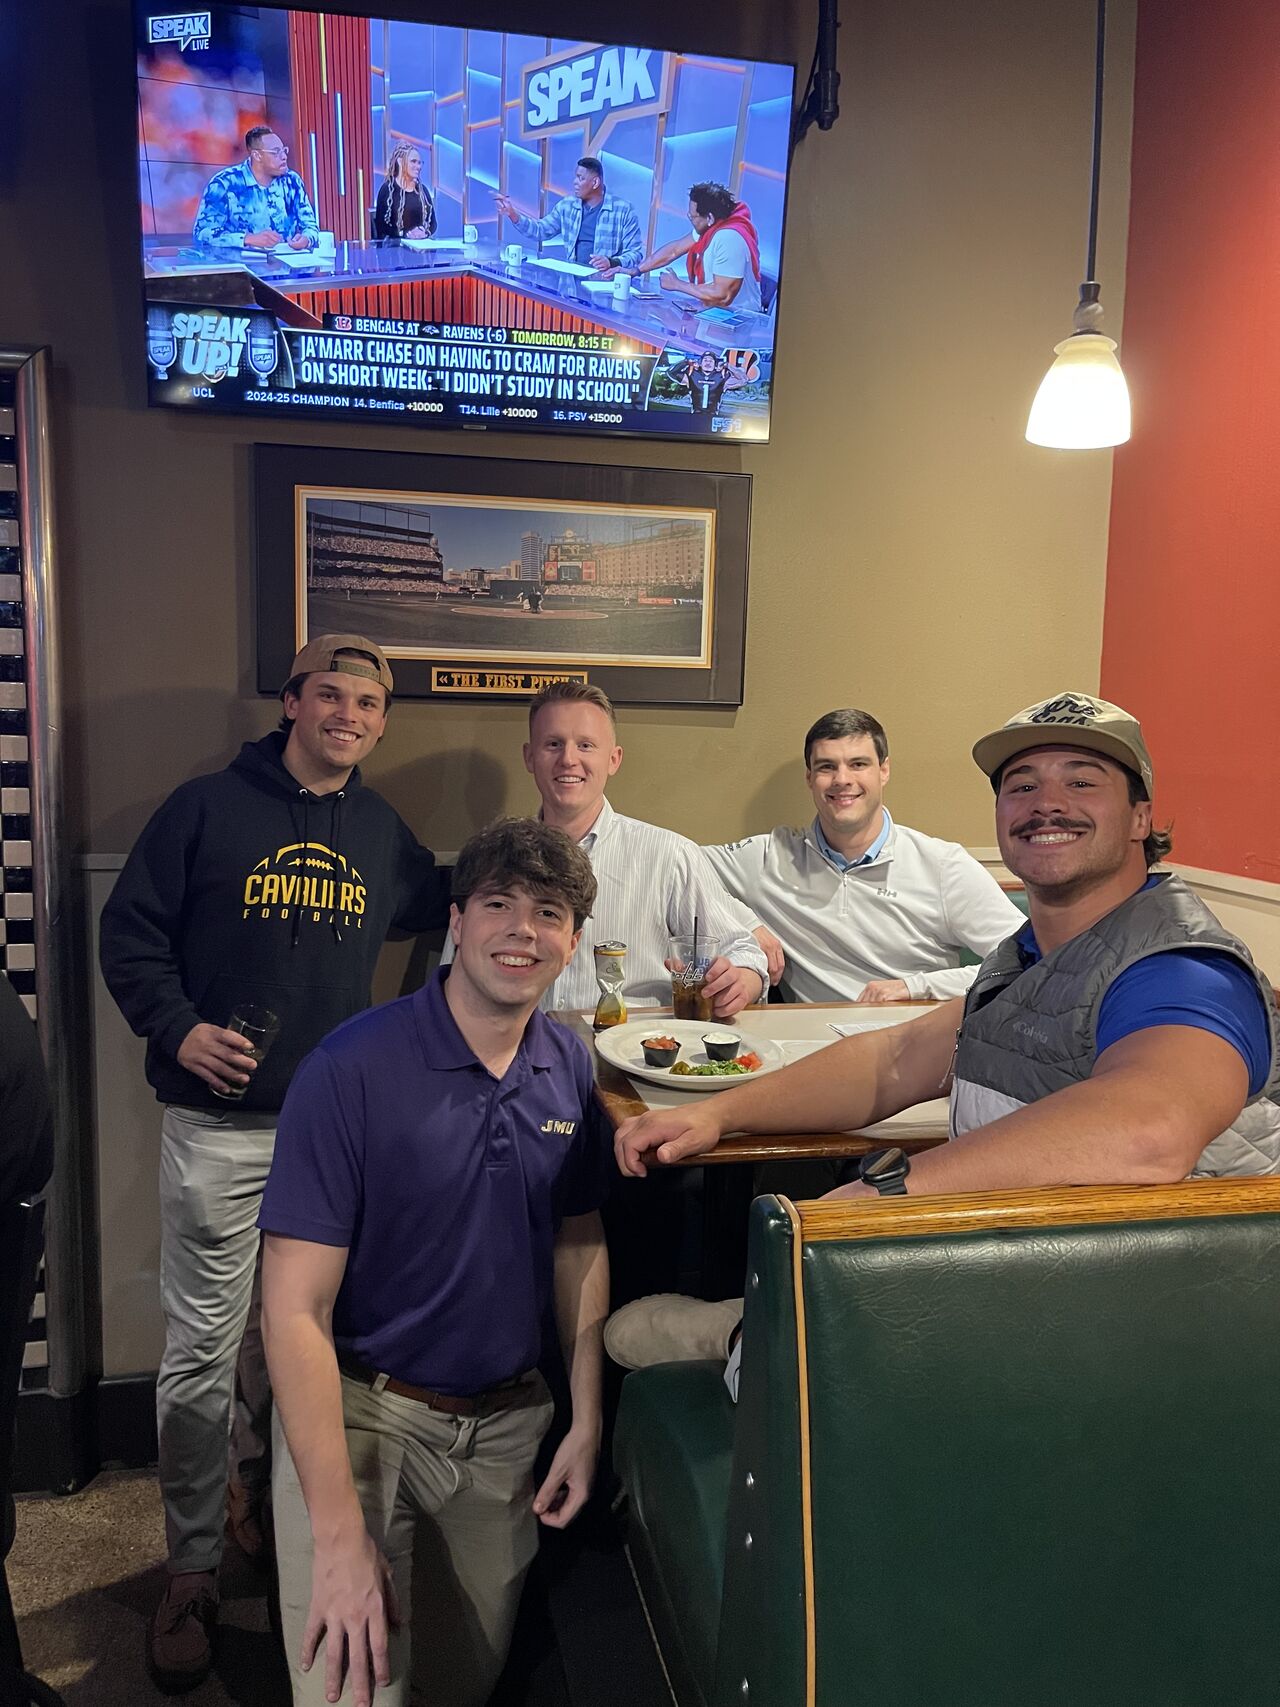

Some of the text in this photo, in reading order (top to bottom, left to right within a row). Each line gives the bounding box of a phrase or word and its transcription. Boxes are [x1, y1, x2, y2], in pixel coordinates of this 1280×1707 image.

[152, 16, 208, 39] SPEAK
[192, 38, 210, 51] LIVE
[528, 47, 655, 127] SPEAK
[172, 313, 250, 343] SPEAK
[356, 318, 614, 350] BENGALS AT RAVENS (-6) TOMORROW, 8:15 ET
[182, 340, 243, 377] UP!
[301, 335, 641, 380] JA'MARR CHASE ON HAVING TO CRAM FOR RAVENS
[193, 387, 215, 398] UCL
[301, 362, 324, 384] ON
[328, 363, 380, 388] SHORT
[382, 367, 433, 391] WEEK:
[453, 372, 504, 395] DIDN'T
[507, 375, 554, 398] STUDY
[557, 379, 573, 400] IN
[577, 380, 640, 404] SCHOOL"
[247, 391, 444, 413] 2024-25 CHAMPION 14. Benfica +10000
[459, 404, 538, 419] T14. Lille +10000
[553, 411, 623, 424] 16. PSV +15000
[451, 673, 480, 687] THE
[485, 674, 525, 689] FIRST
[541, 1120, 576, 1135] JMU
